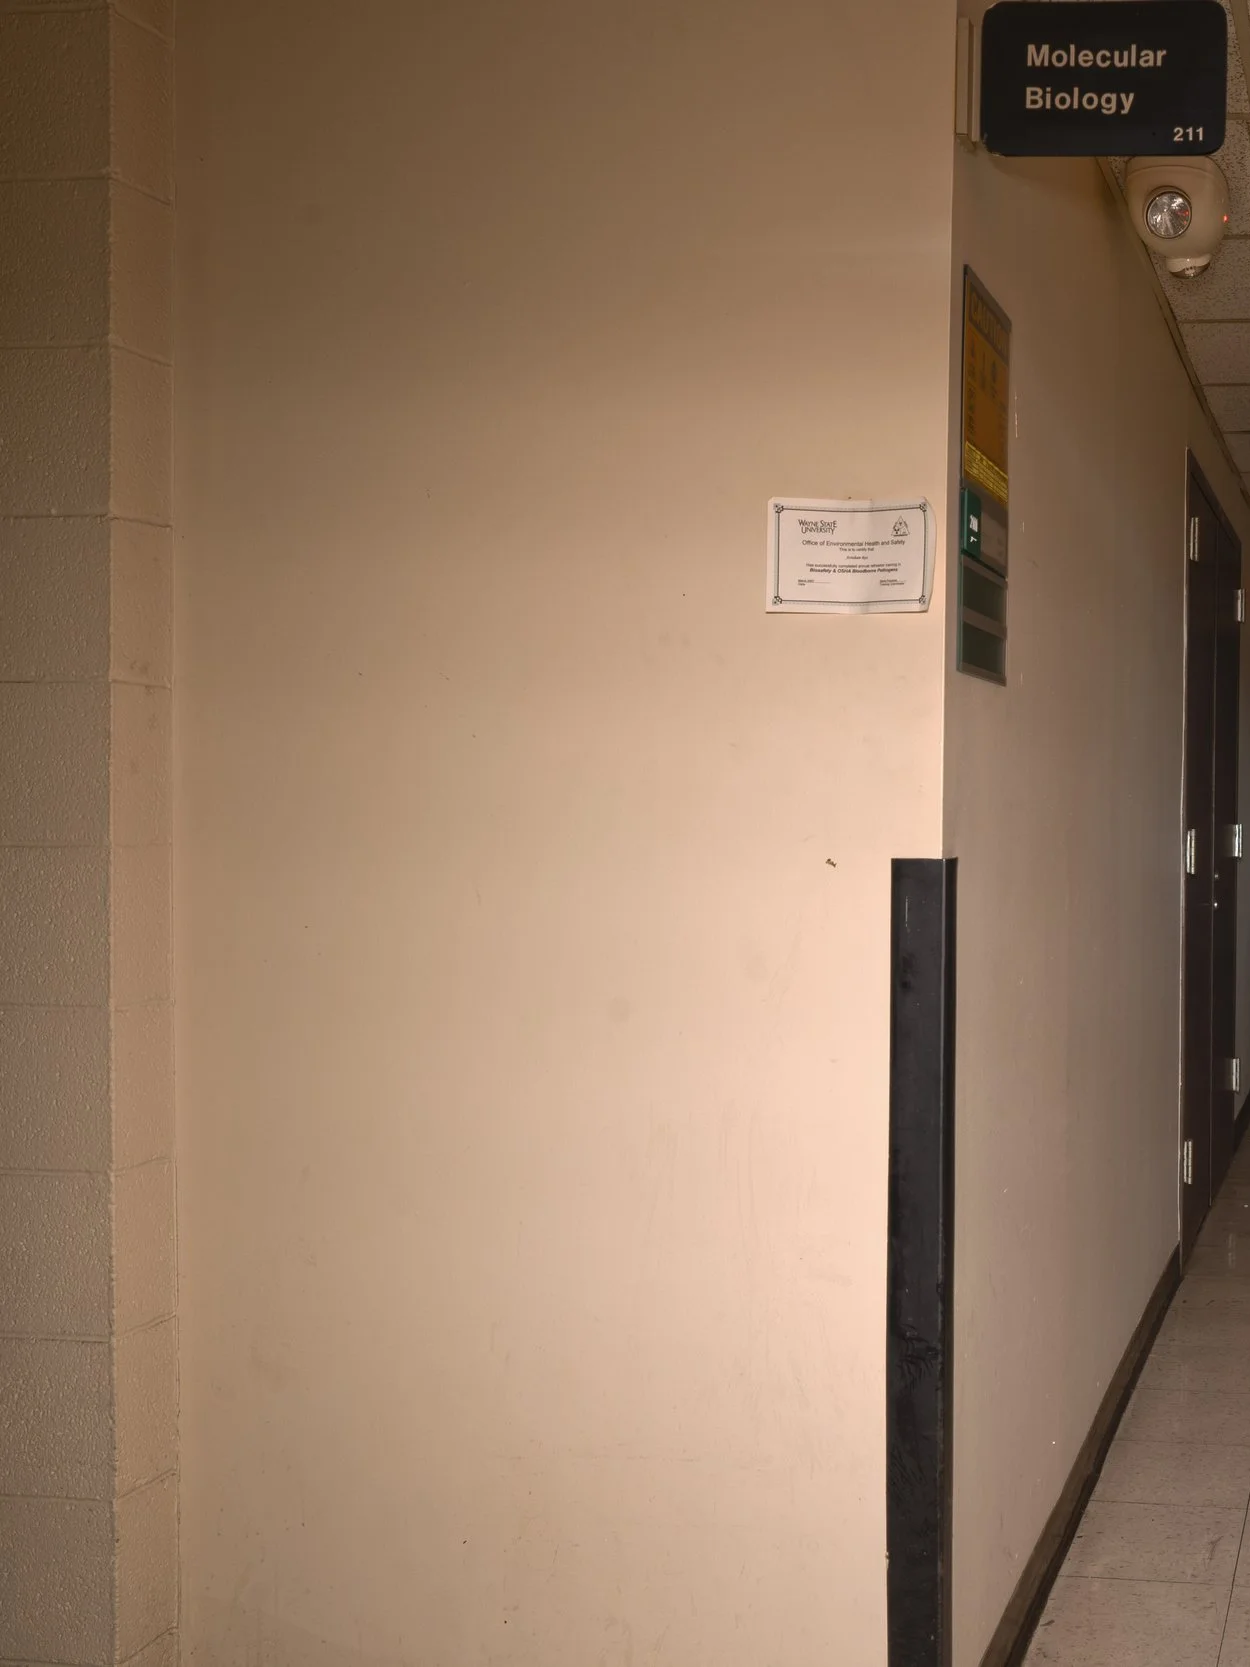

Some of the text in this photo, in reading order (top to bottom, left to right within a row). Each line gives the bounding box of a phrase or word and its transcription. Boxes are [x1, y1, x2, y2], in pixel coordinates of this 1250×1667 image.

[1027, 44, 1167, 68] Molecular
[1025, 87, 1135, 115] Biology
[1173, 127, 1204, 142] 211
[798, 519, 837, 528] WAYNE STATE
[801, 527, 835, 535] UNIVERSITY
